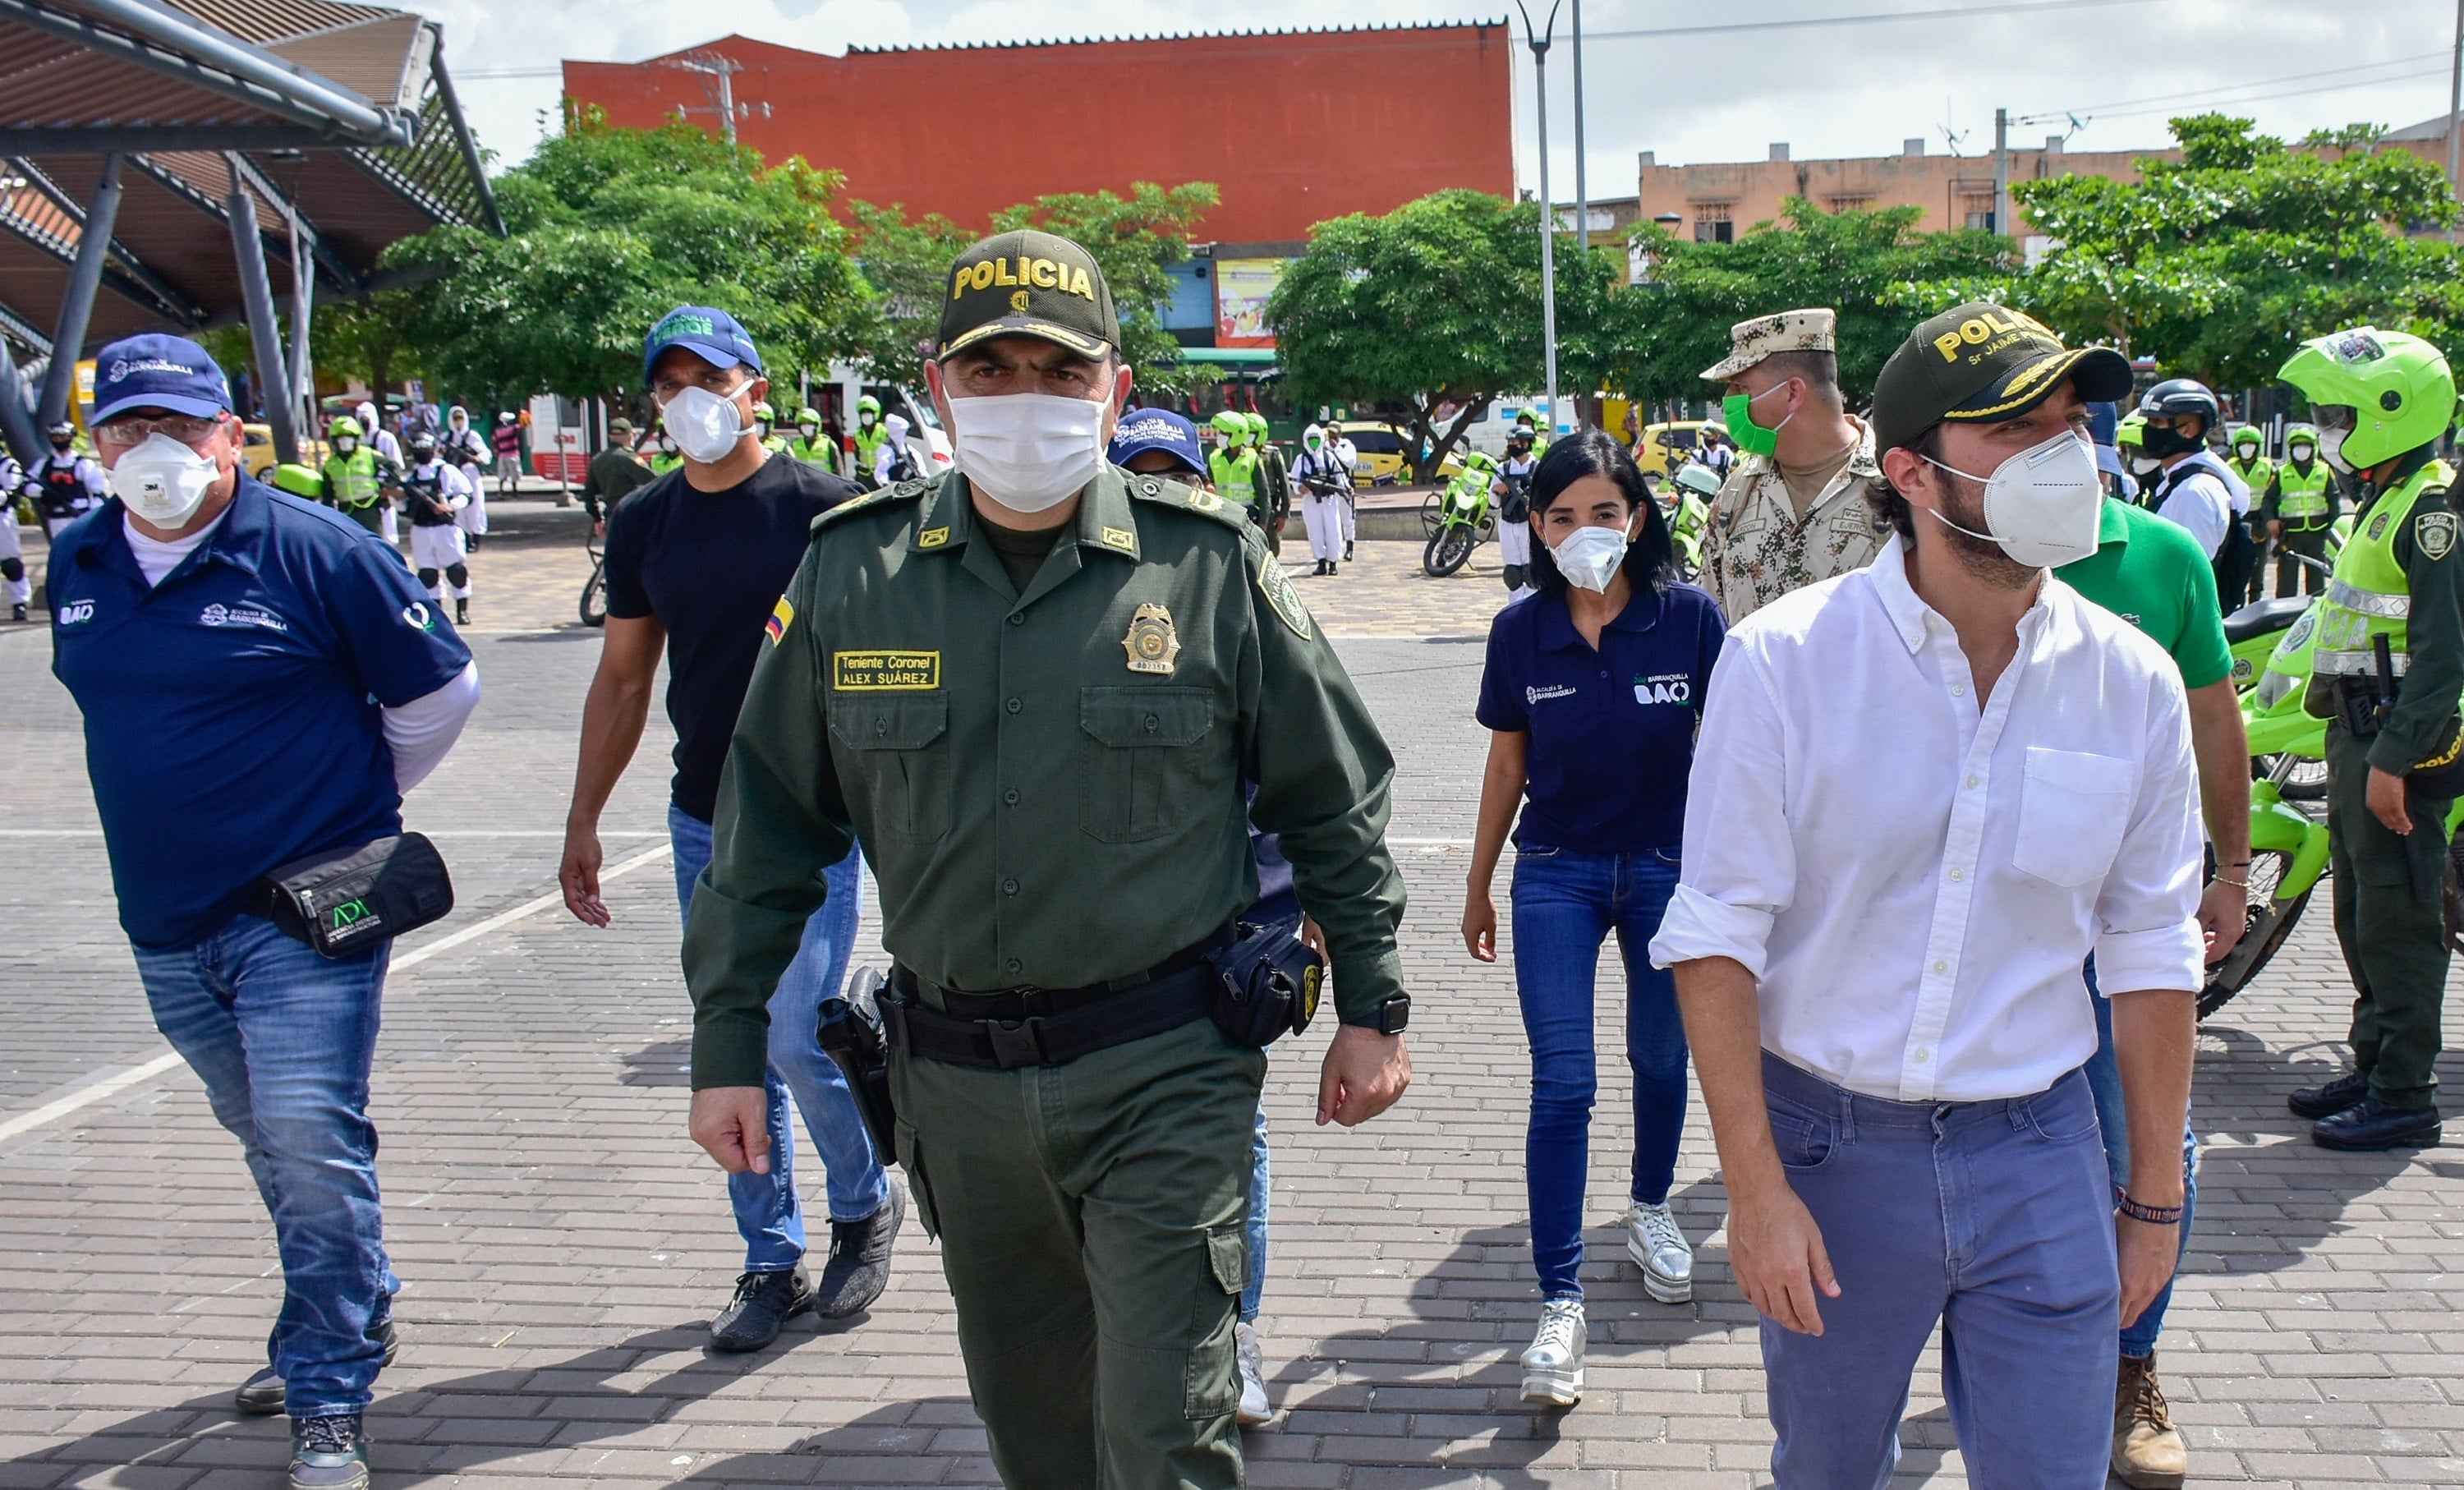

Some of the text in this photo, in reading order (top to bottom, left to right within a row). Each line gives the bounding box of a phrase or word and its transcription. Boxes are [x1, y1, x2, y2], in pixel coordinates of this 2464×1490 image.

[954, 256, 1094, 301] POLICIA
[1933, 309, 2066, 363] POLIC
[1985, 333, 2020, 355] JAIME
[843, 656, 930, 669] Teniente Coronel
[844, 670, 928, 684] ALEX SUÁREZ
[1648, 674, 1689, 683] BARRANQUILLA
[1538, 687, 1576, 699] BARRANQUILLA
